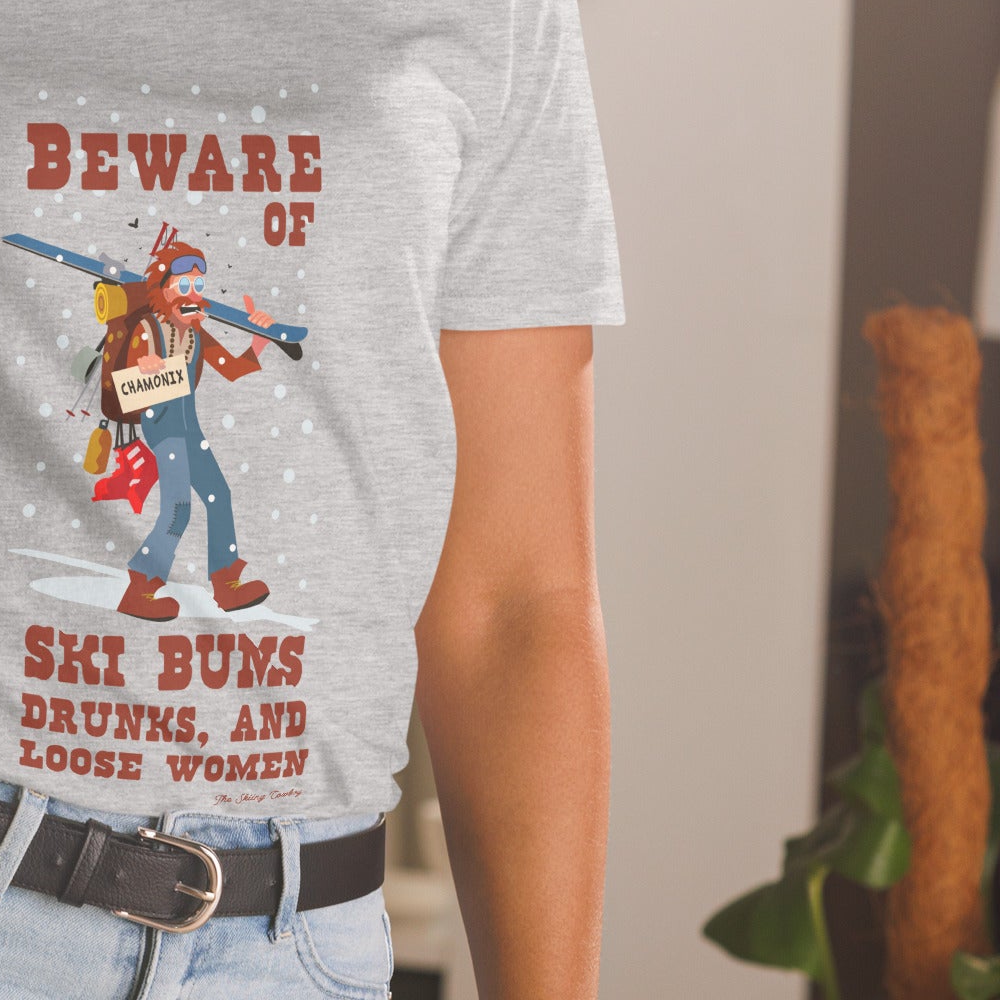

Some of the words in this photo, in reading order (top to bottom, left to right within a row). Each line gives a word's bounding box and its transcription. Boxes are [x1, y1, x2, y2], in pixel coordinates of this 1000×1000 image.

[264, 202, 315, 246] OF
[121, 369, 184, 396] CHAMONIX
[24, 624, 125, 687] SKI
[158, 633, 306, 691] BUMS
[21, 692, 209, 748] DRUNKS,
[230, 700, 307, 742] AND
[19, 739, 143, 781] LOOSE
[166, 749, 309, 782] WOMEN
[213, 794, 232, 806] The
